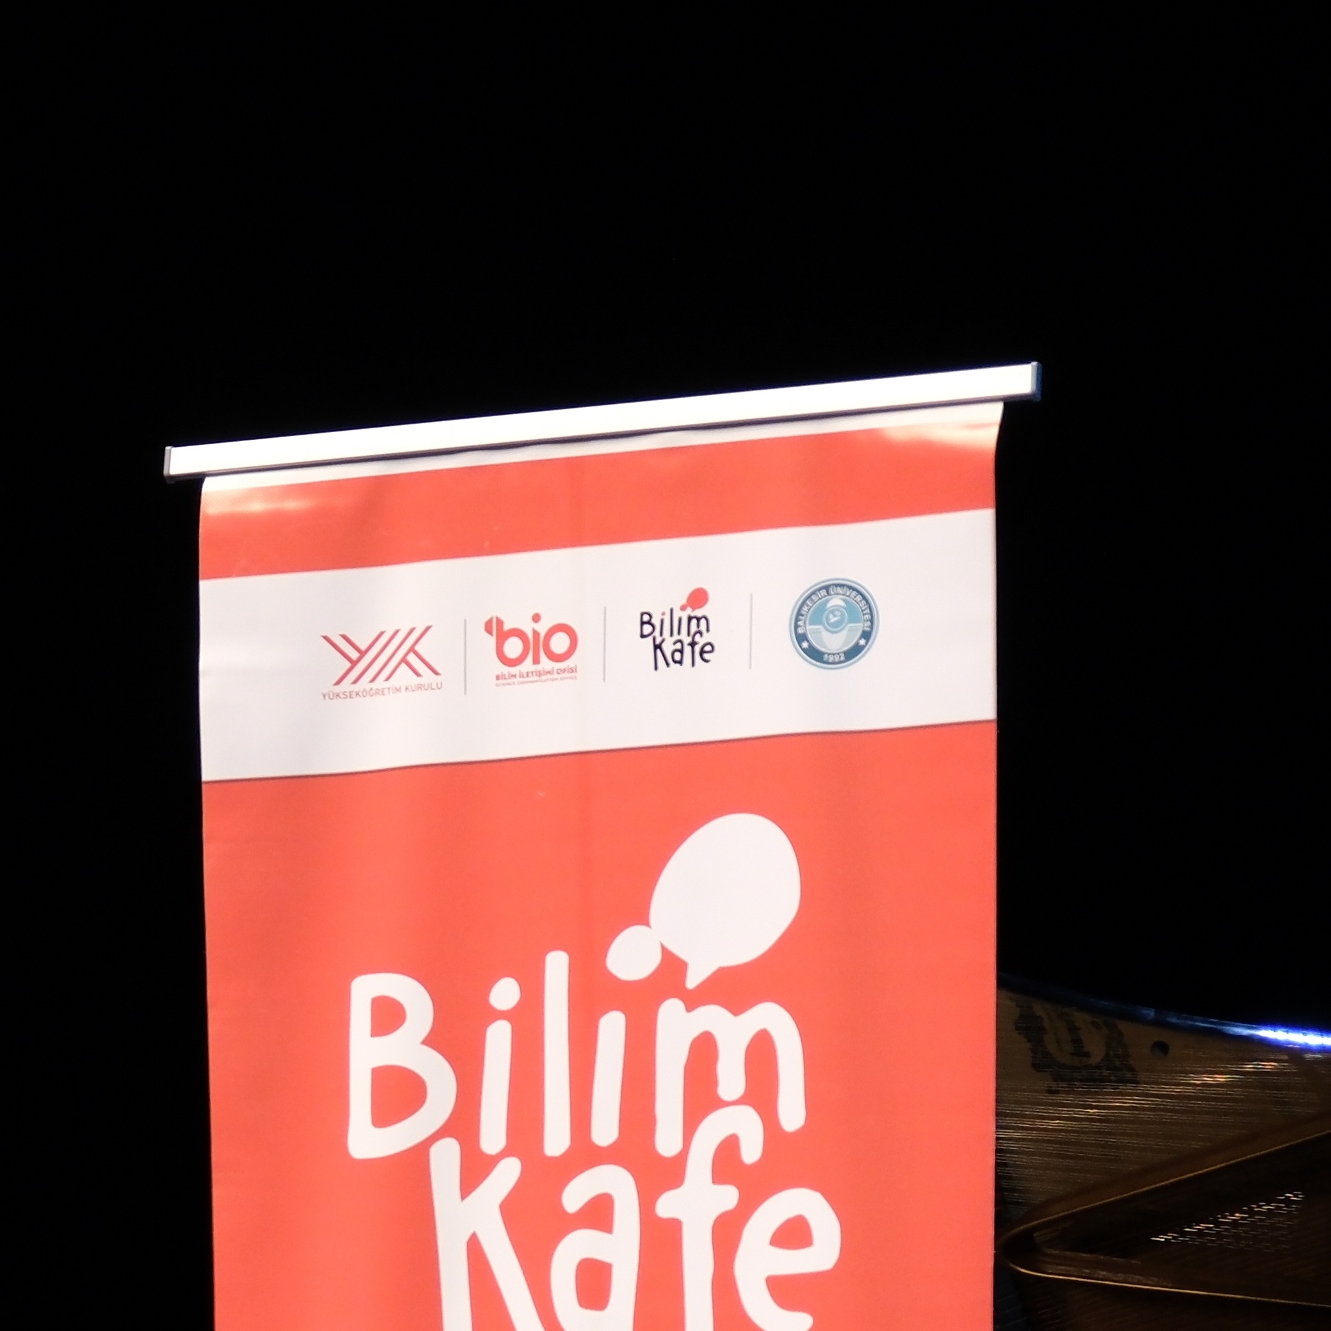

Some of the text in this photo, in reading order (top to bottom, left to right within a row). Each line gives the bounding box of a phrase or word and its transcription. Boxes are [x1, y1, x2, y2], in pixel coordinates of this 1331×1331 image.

[640, 607, 710, 639] Bilim
[653, 629, 715, 671] Kafe
[823, 653, 845, 662] 1992
[404, 681, 443, 693] KURULU
[347, 949, 807, 1160] Bilim
